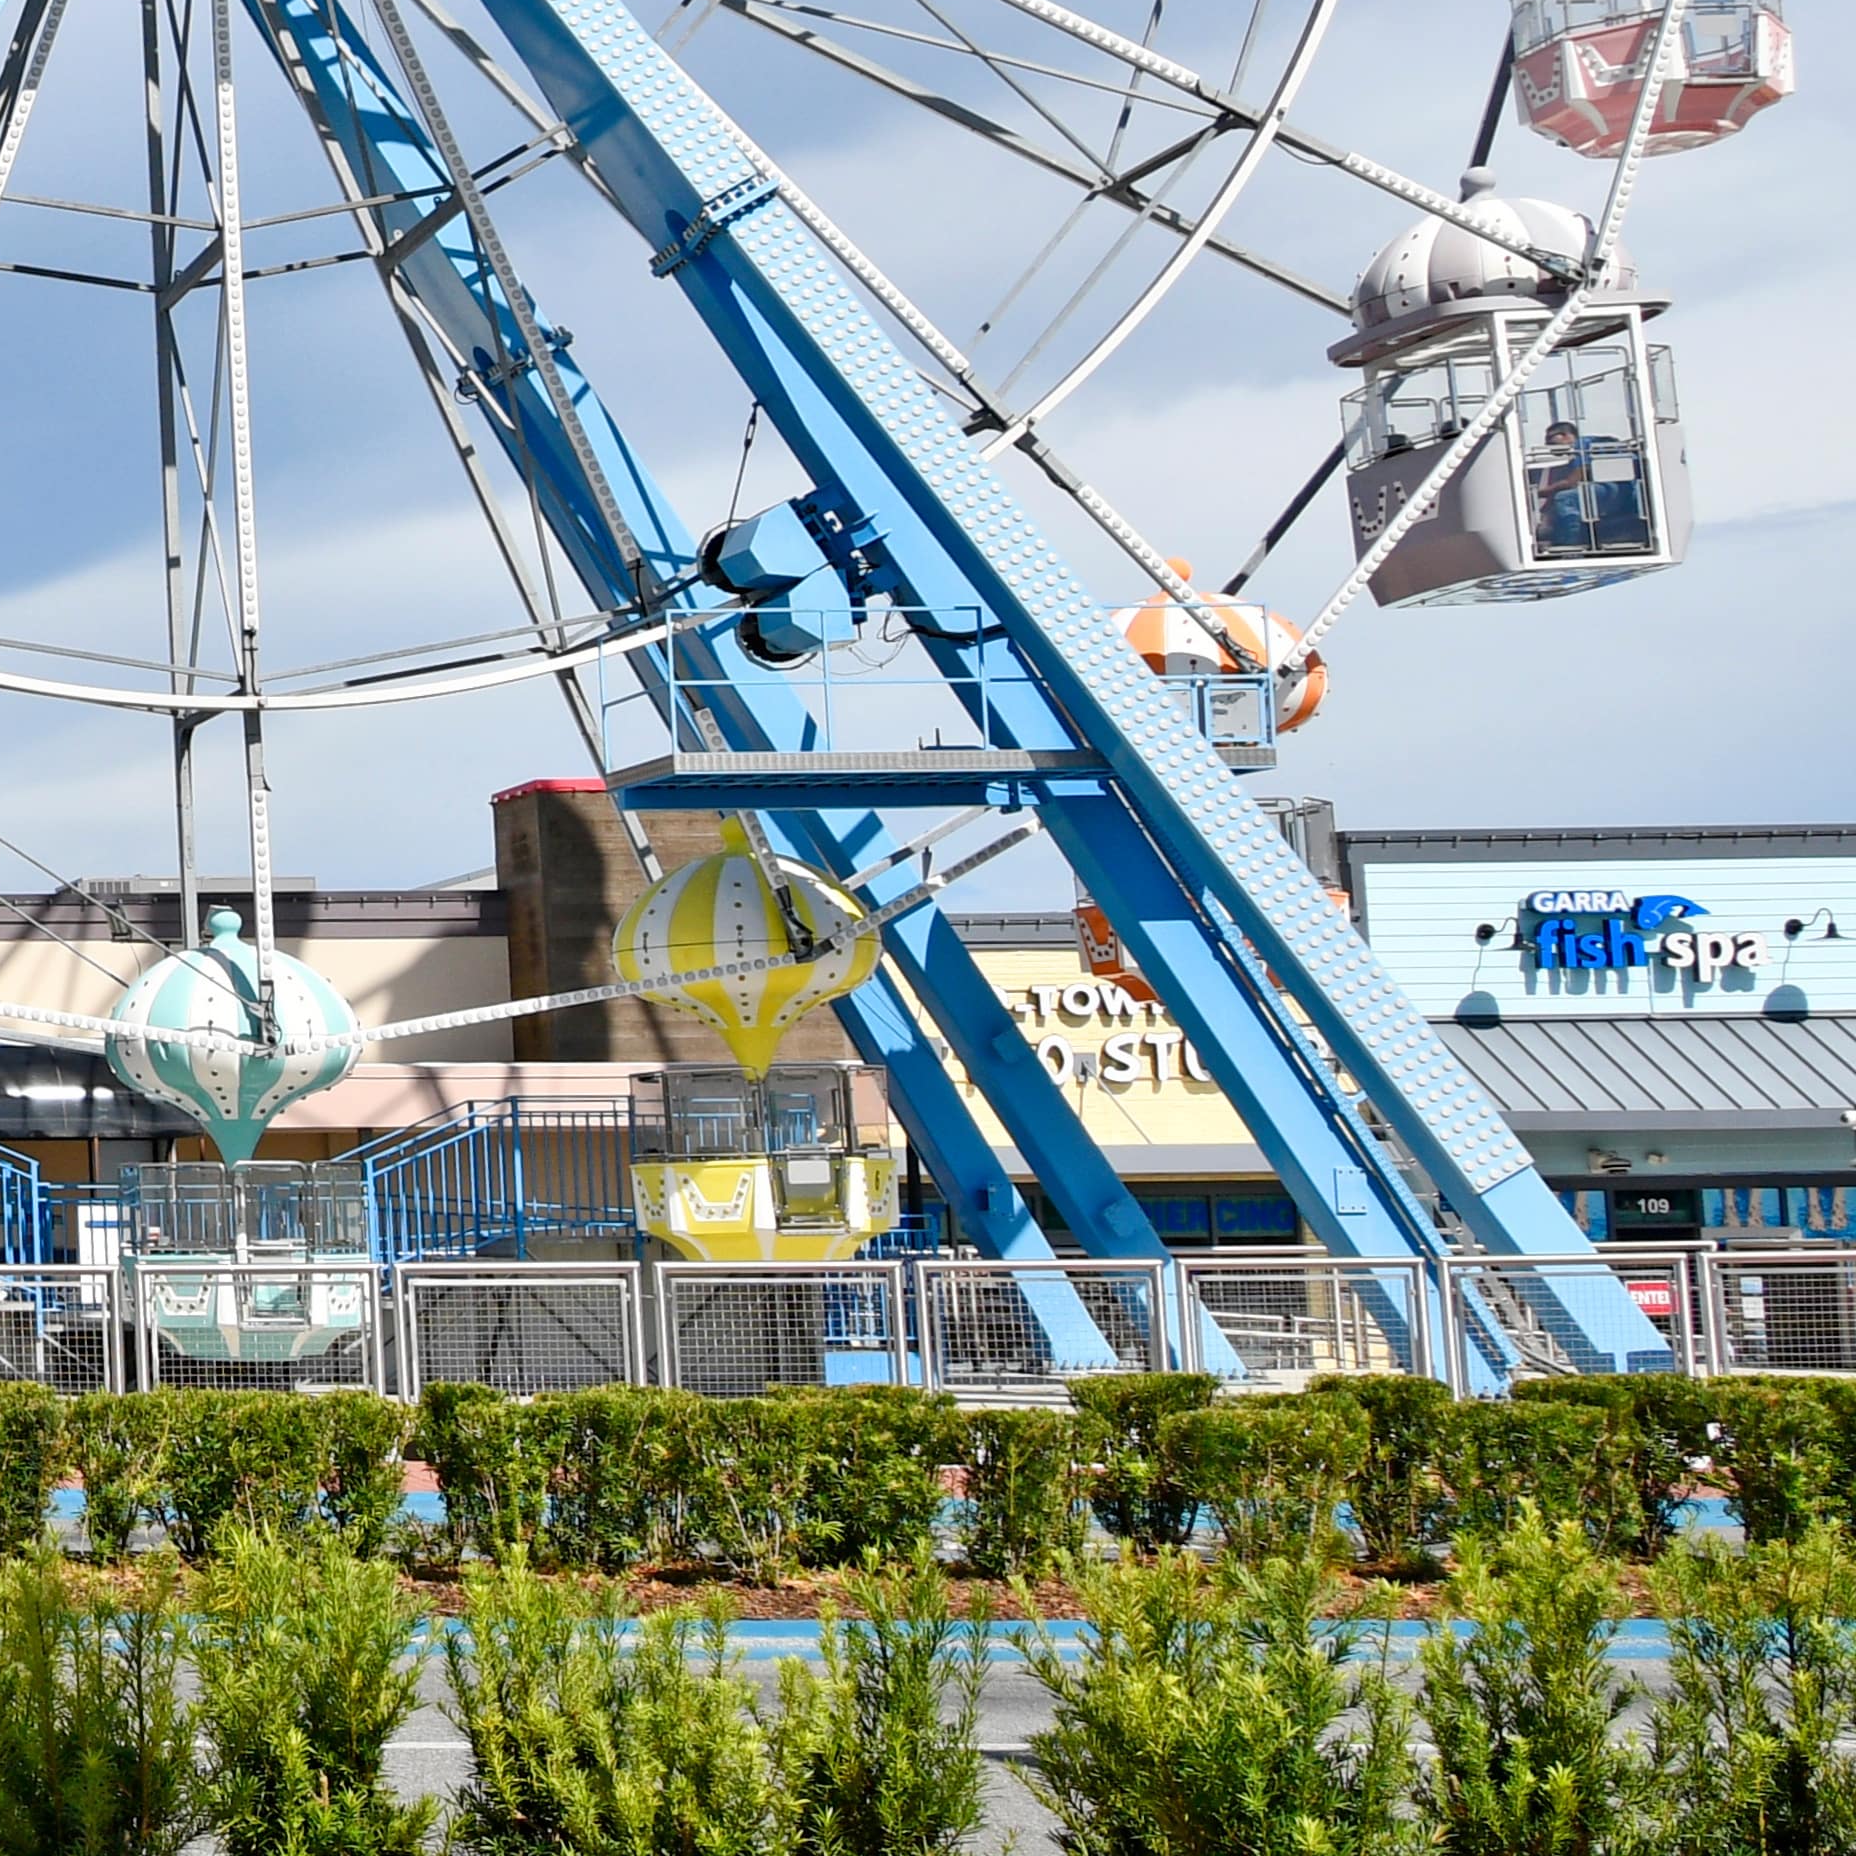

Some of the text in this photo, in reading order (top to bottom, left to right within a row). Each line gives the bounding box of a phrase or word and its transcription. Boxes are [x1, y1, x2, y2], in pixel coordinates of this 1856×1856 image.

[1531, 890, 1630, 914] GARRA
[1536, 918, 1770, 984] fish spa
[1637, 1197, 1670, 1214] 109
